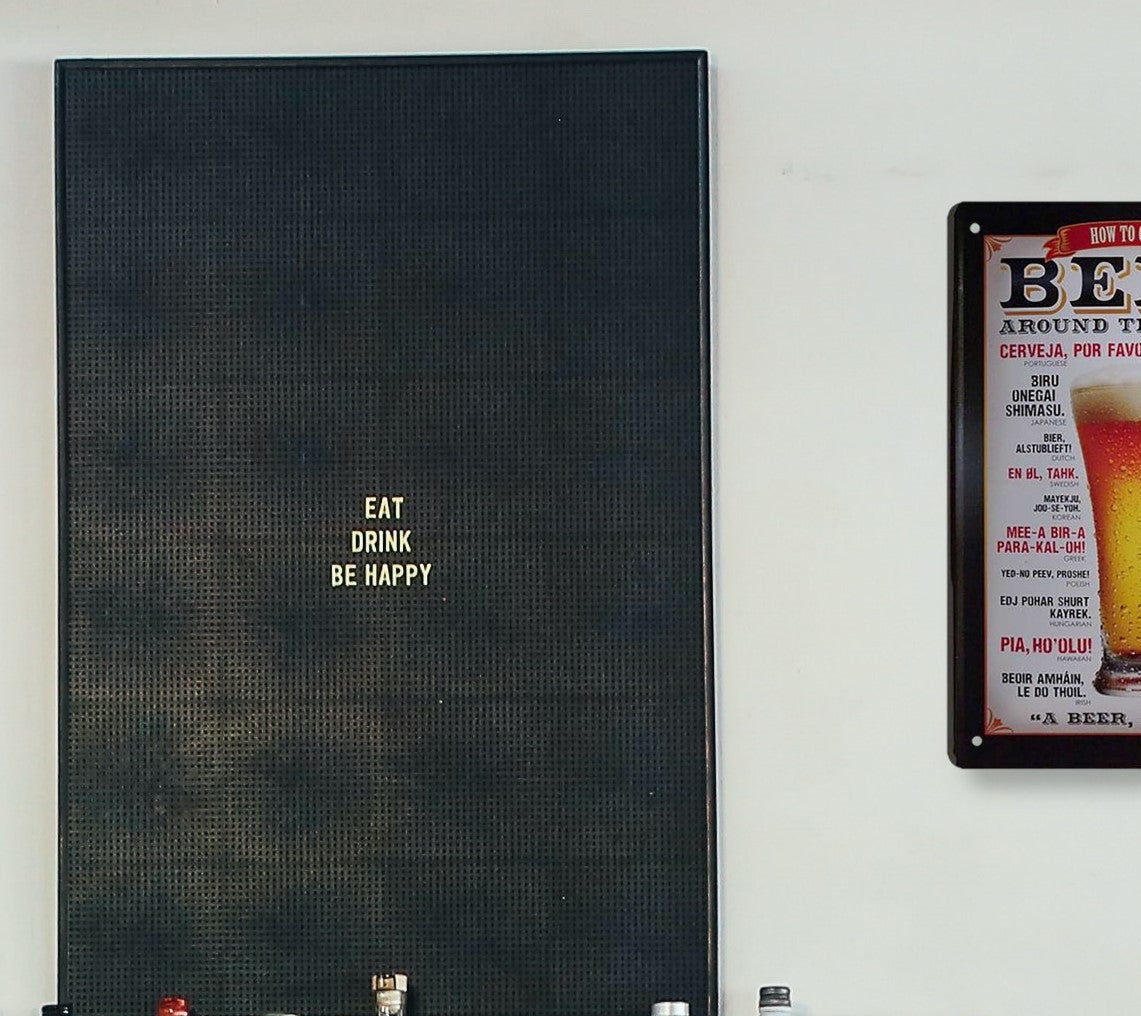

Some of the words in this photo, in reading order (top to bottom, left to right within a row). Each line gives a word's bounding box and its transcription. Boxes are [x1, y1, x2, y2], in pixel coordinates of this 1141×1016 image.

[1090, 227, 1118, 244] HOW
[1119, 225, 1137, 242] TO
[999, 317, 1109, 335] AROUND
[999, 343, 1068, 360] CERVEJA,
[1073, 343, 1101, 358] POR
[1012, 389, 1055, 402] ONEGAI
[1006, 404, 1065, 417] SHIMASU.
[1008, 467, 1022, 479] EN
[366, 497, 403, 519] EAT
[1006, 526, 1046, 539] MEE-A
[1051, 526, 1086, 539] BIR-A
[352, 530, 411, 553] DRINK
[997, 540, 1085, 554] PARA-KAL-OH!
[332, 564, 357, 587] BE
[366, 564, 431, 586] HAPPY
[1050, 608, 1091, 619] KAYREK.
[1001, 637, 1030, 655] PIA,
[1067, 712, 1133, 728] BEER,
